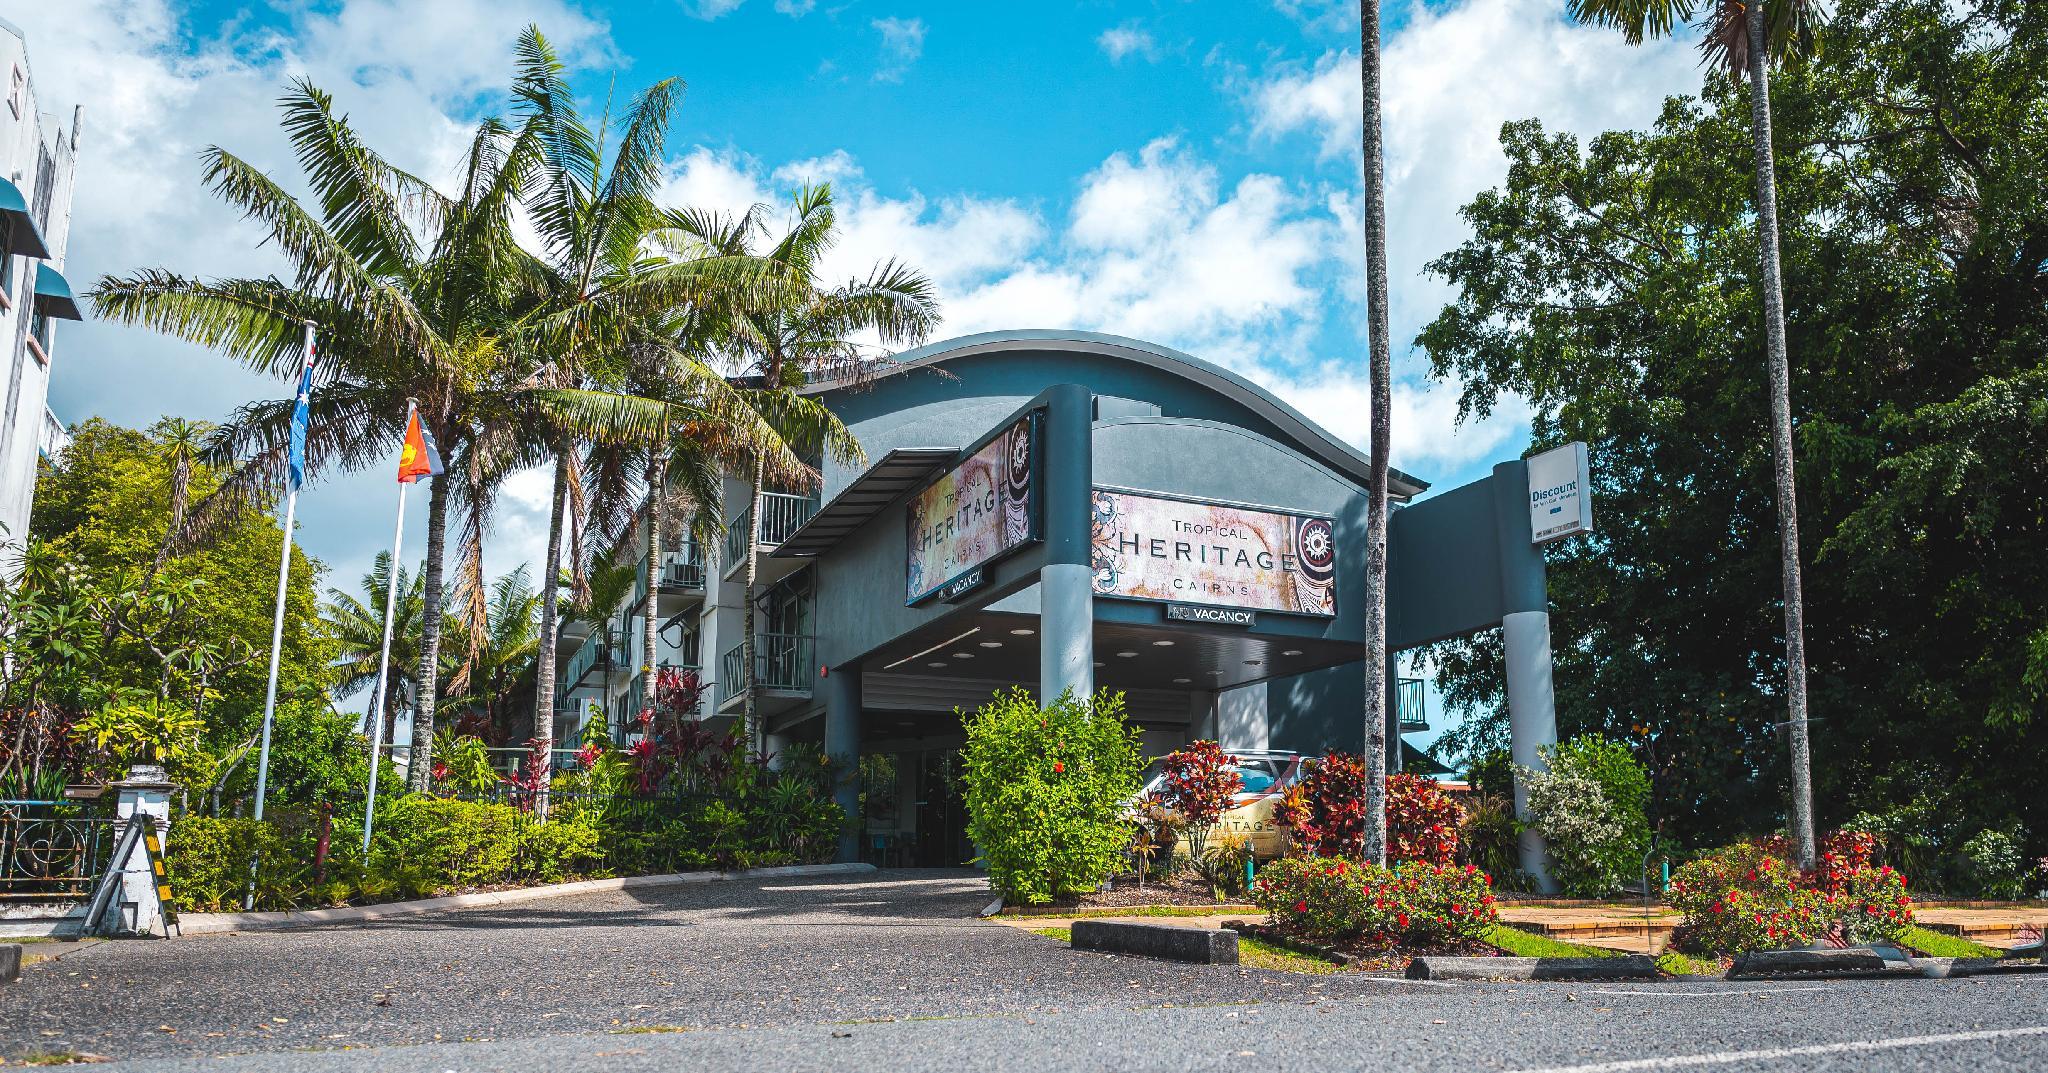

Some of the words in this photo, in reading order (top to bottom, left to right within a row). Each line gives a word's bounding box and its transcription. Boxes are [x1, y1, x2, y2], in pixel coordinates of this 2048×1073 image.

[1532, 480, 1577, 502] Discount
[922, 480, 1009, 551] HERITAGE
[1118, 531, 1297, 573] HERITAGE
[951, 571, 981, 594] VACANCY
[1173, 578, 1249, 596] CAIRNS
[1193, 608, 1251, 623] VACANCY
[1214, 821, 1275, 831] RITAGE
